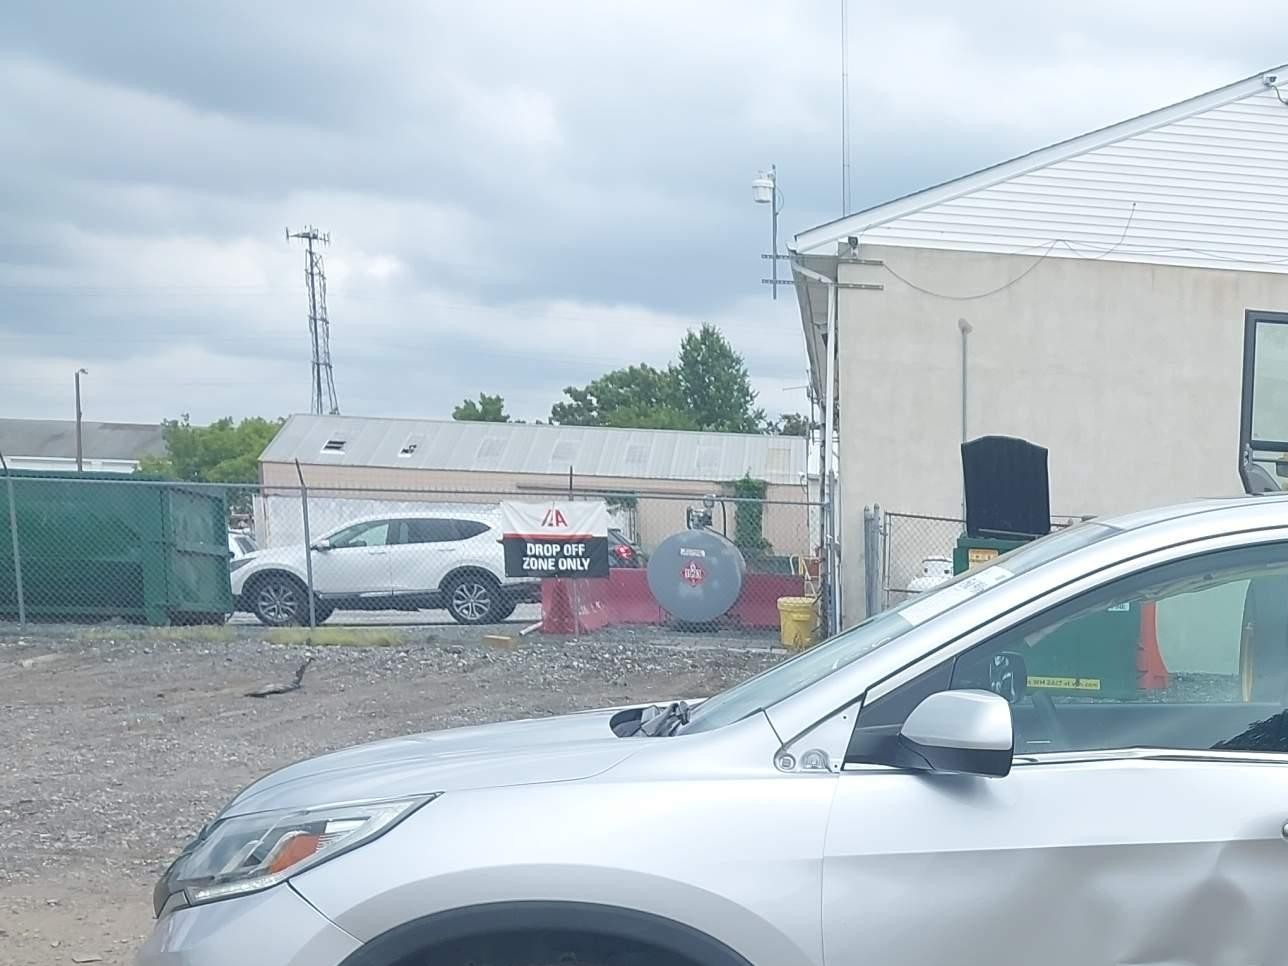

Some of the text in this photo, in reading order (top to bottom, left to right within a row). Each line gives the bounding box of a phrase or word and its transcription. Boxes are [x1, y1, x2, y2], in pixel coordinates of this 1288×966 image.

[526, 543, 586, 556] DROP OFF
[522, 557, 590, 570] ZONE ONLY
